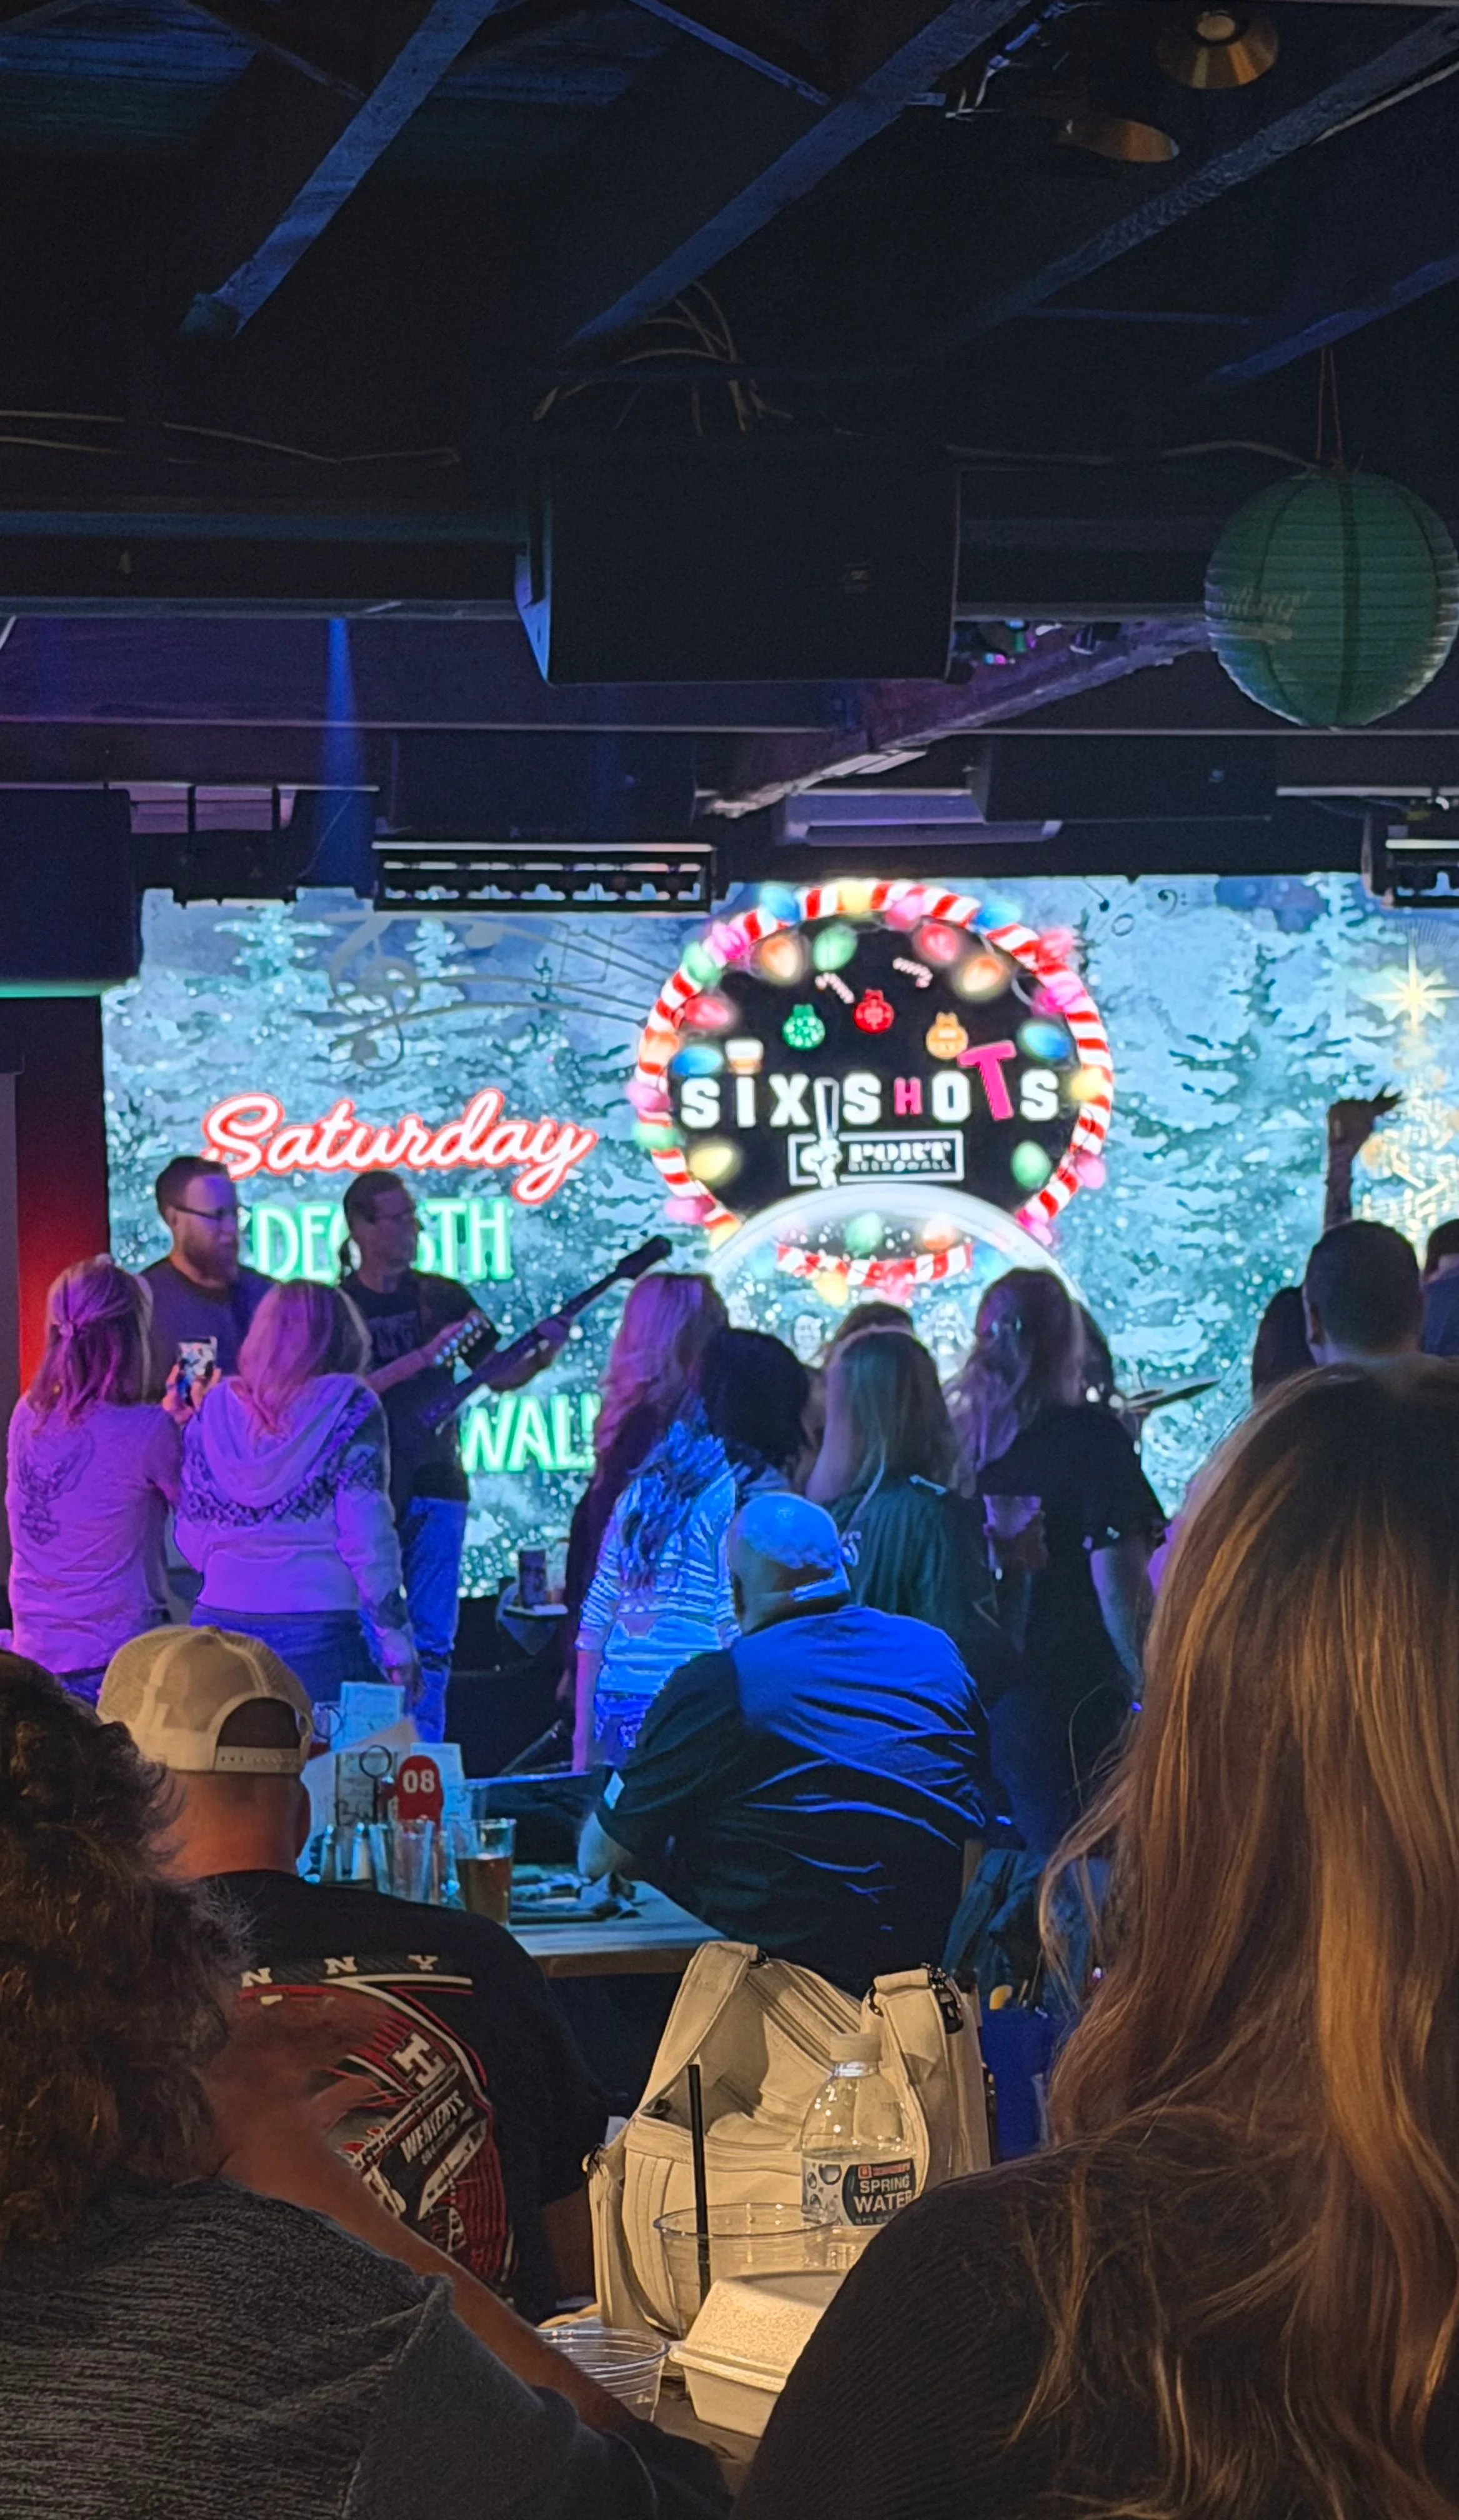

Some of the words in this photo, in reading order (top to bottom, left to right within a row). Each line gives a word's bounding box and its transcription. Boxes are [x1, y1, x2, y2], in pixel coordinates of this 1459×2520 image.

[681, 1069, 810, 1128] SIX
[842, 1040, 1058, 1124] SHOTS
[201, 1088, 599, 1204] Saturday
[402, 1769, 436, 1793] 08
[859, 2174, 910, 2194] SPRING
[853, 2189, 912, 2214] WATER
